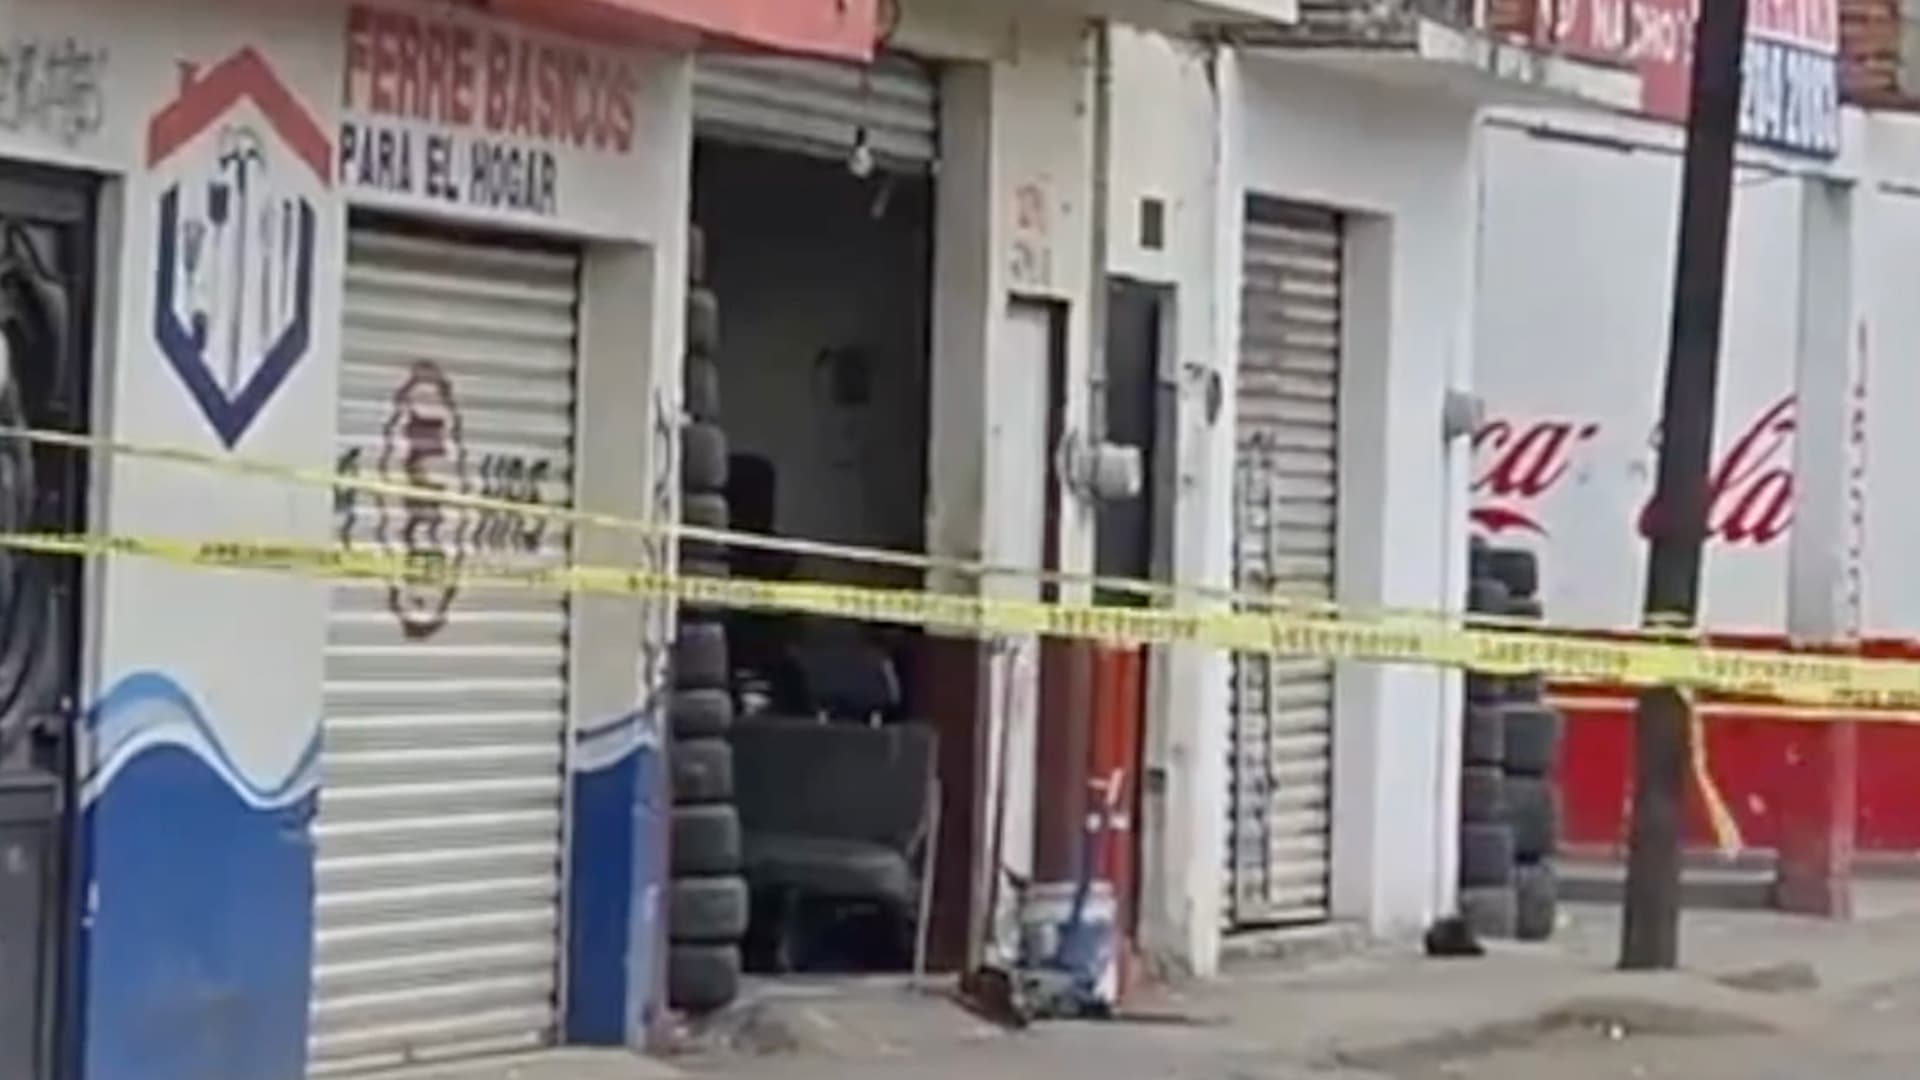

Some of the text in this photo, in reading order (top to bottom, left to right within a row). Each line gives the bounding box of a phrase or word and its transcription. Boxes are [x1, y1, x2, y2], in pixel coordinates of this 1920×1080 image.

[342, 6, 474, 127] FERRE
[340, 121, 558, 214] PARA EL HOGAR
